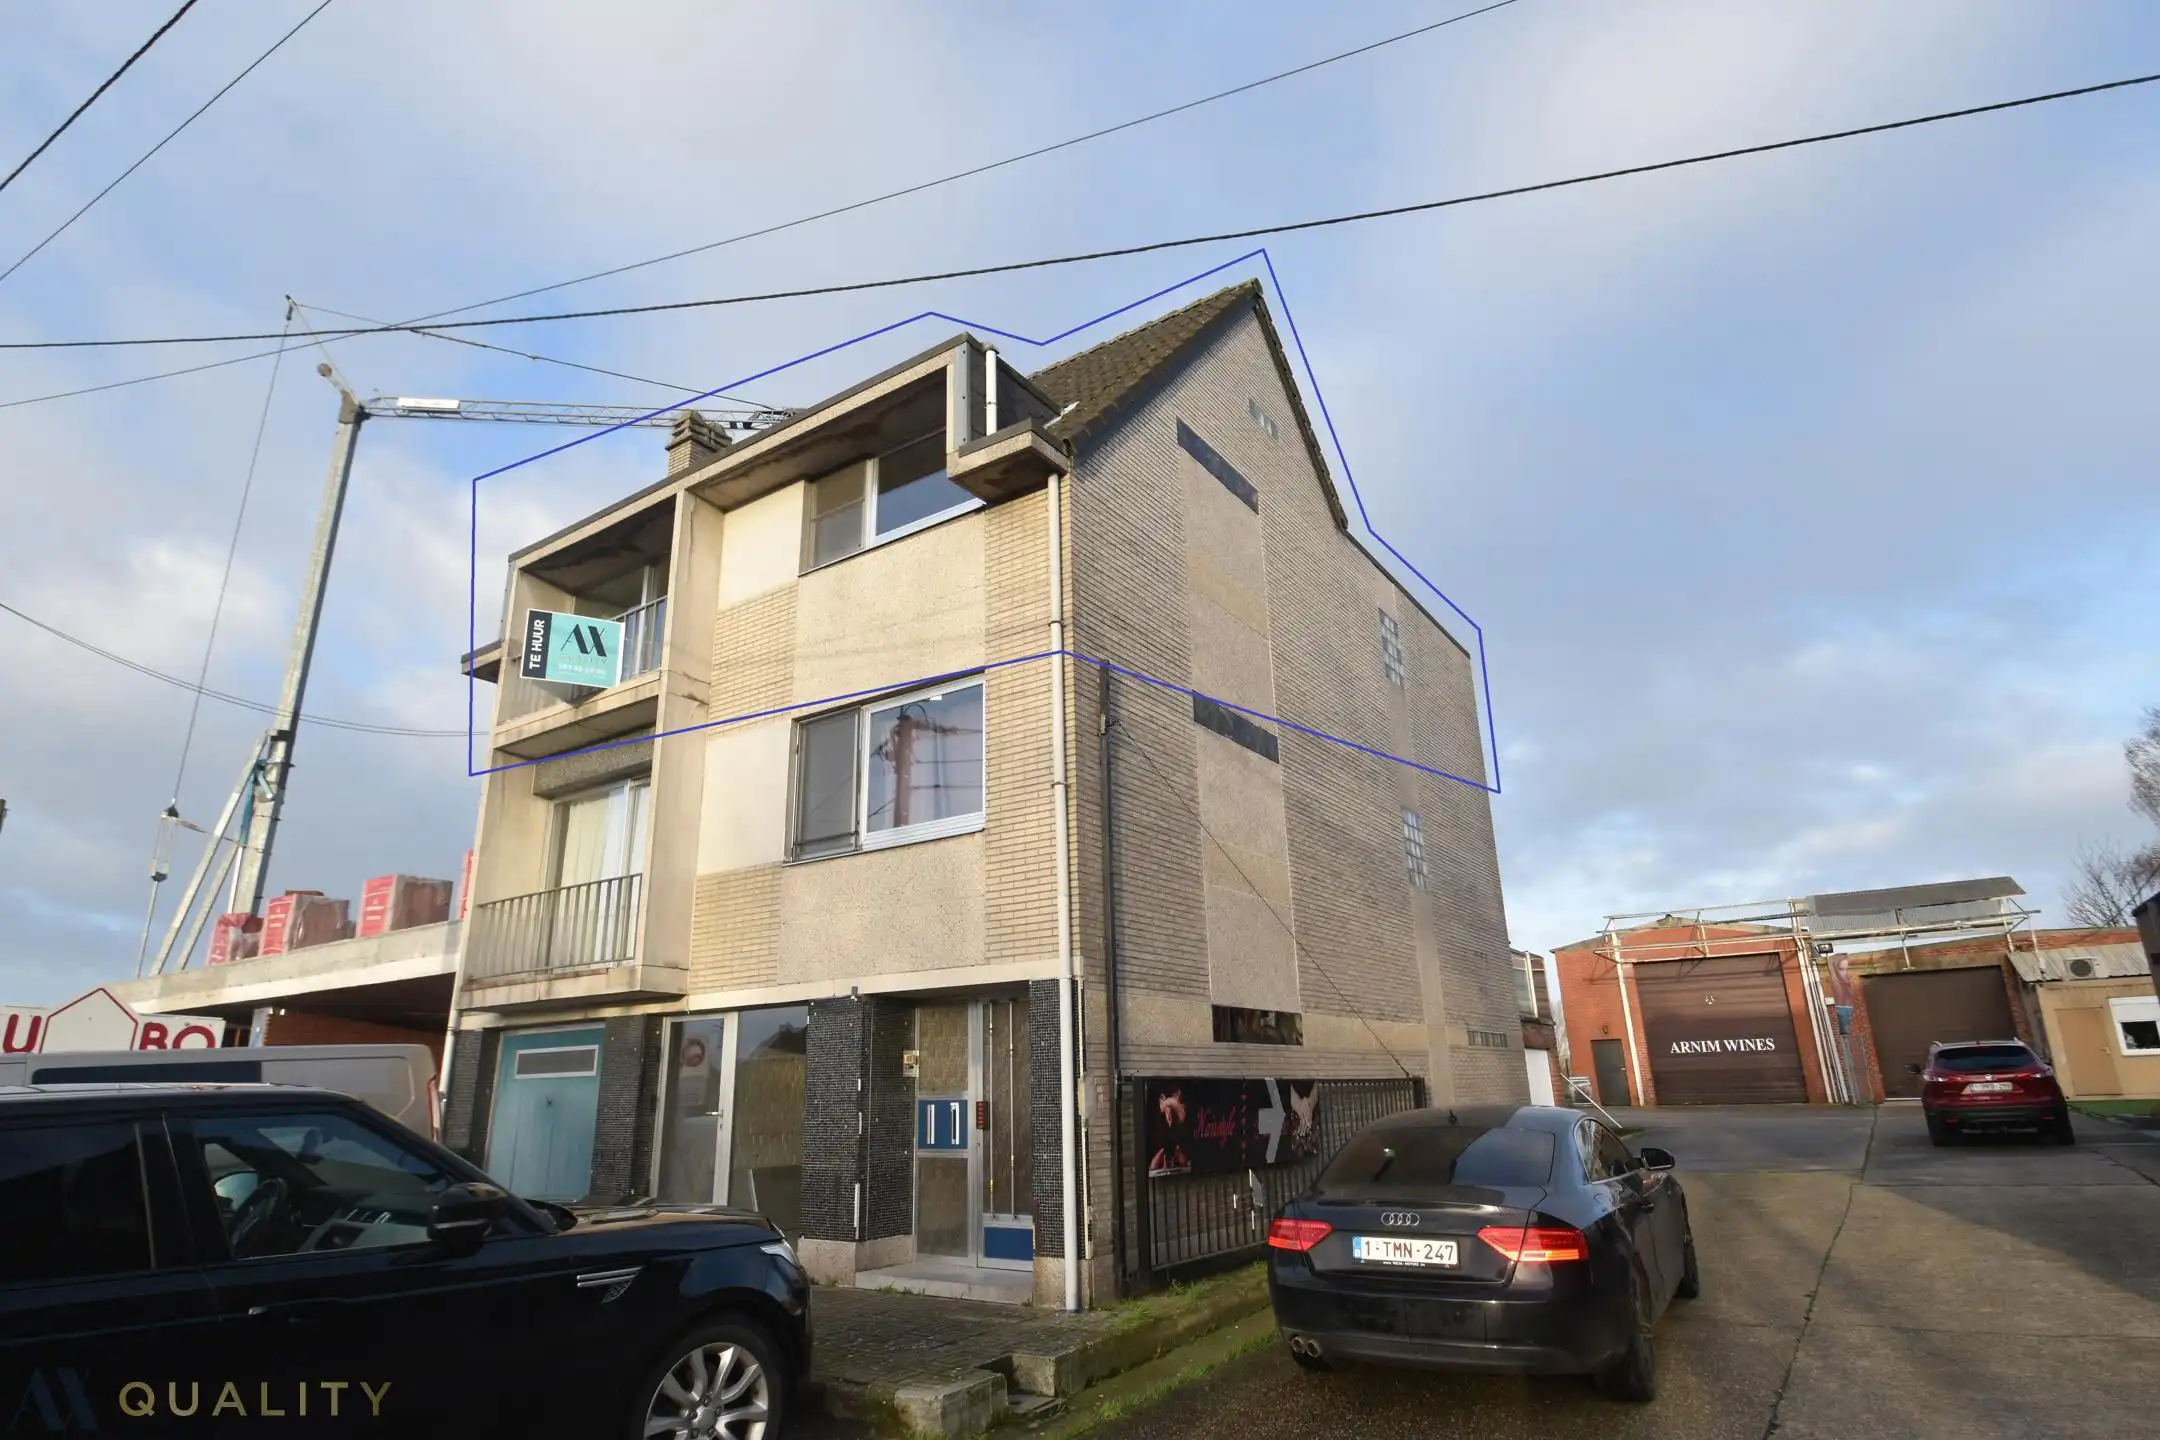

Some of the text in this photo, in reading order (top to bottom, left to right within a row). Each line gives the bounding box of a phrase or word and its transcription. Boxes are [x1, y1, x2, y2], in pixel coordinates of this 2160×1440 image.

[529, 619, 545, 669] TE HUUR
[1670, 1037, 1776, 1054] ARNIM WINES
